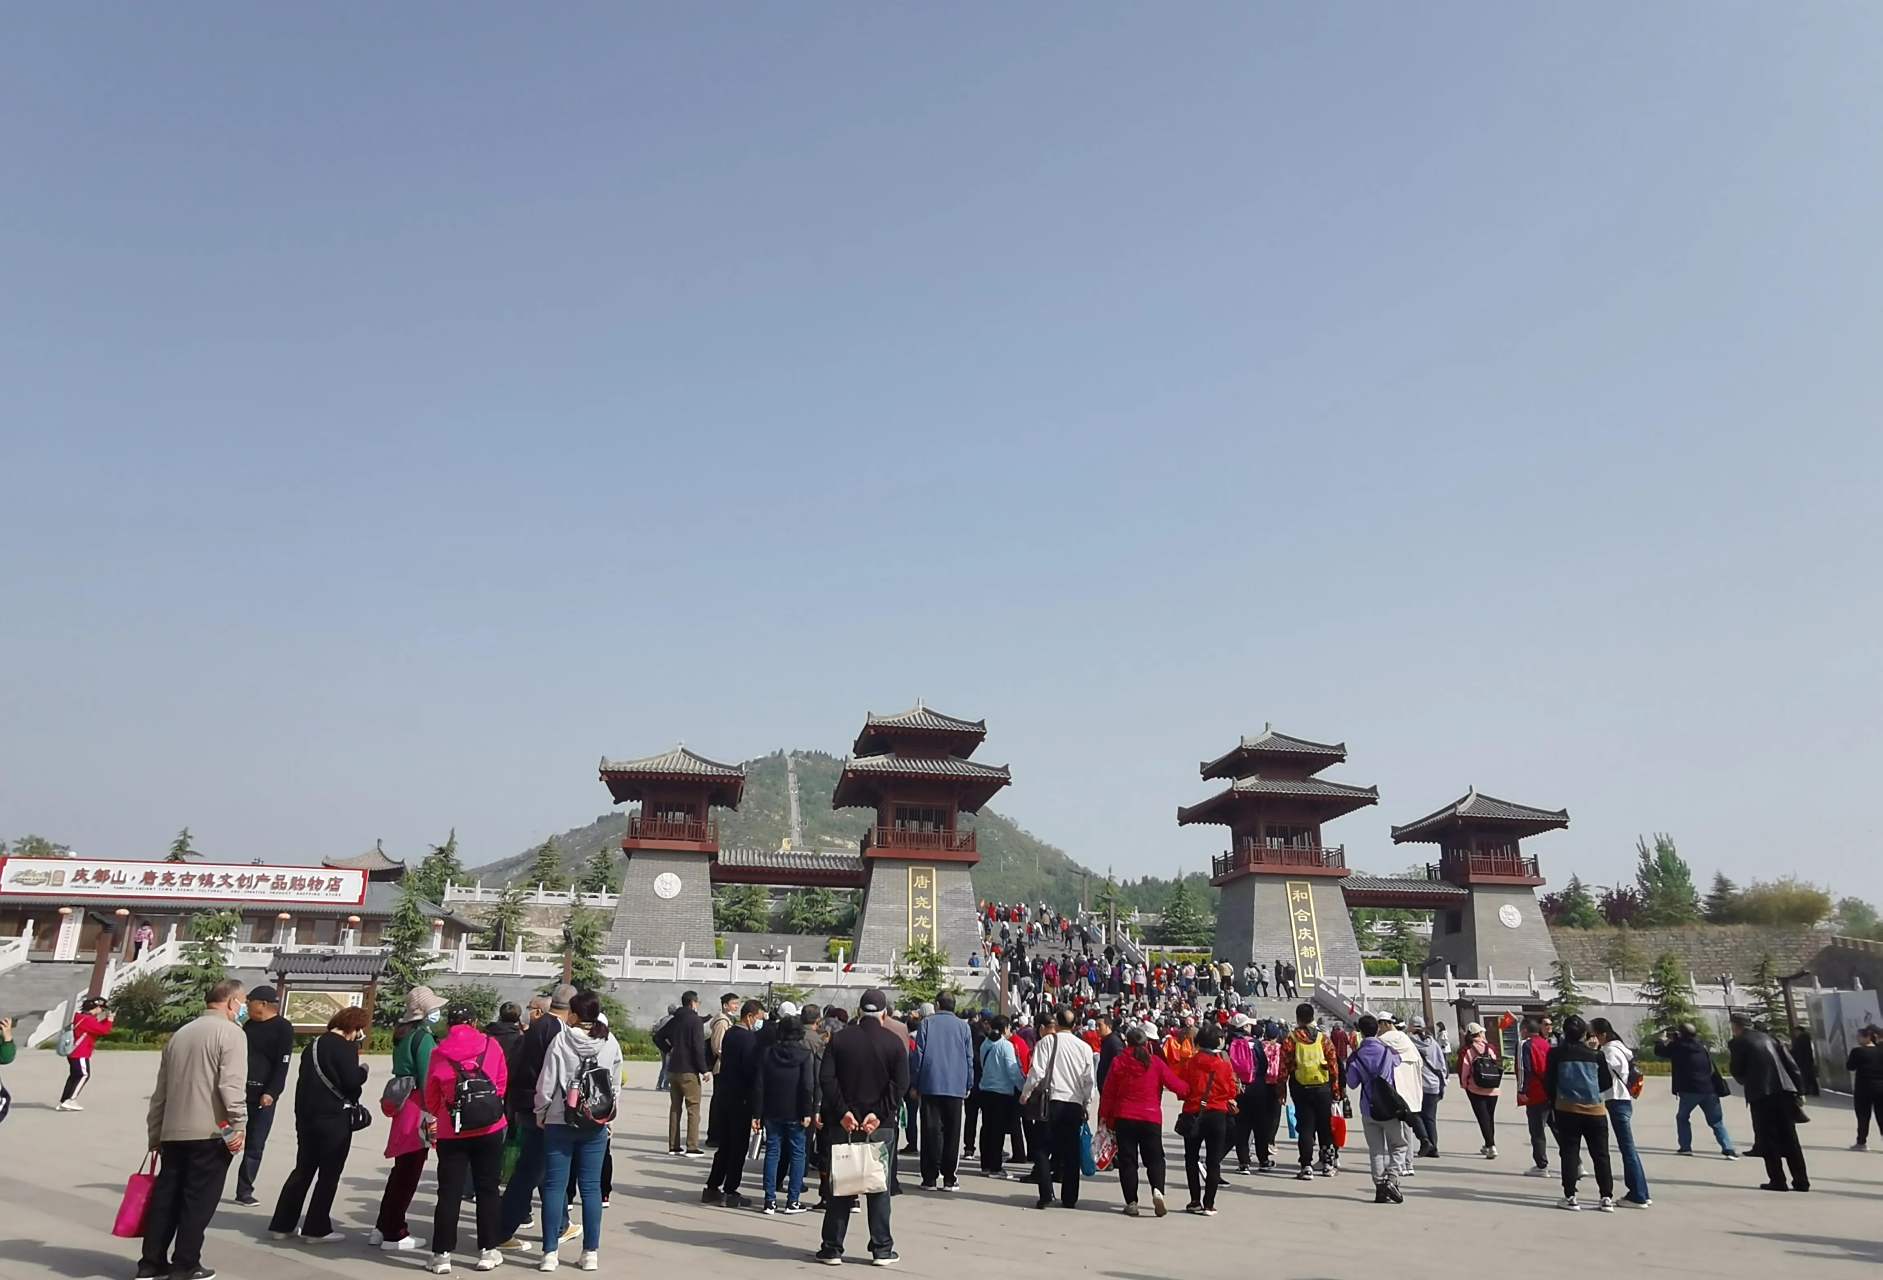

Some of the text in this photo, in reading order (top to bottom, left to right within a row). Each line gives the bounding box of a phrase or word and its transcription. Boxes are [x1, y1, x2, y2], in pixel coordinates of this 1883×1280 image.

[1292, 890, 1316, 978] 和合庆都山
